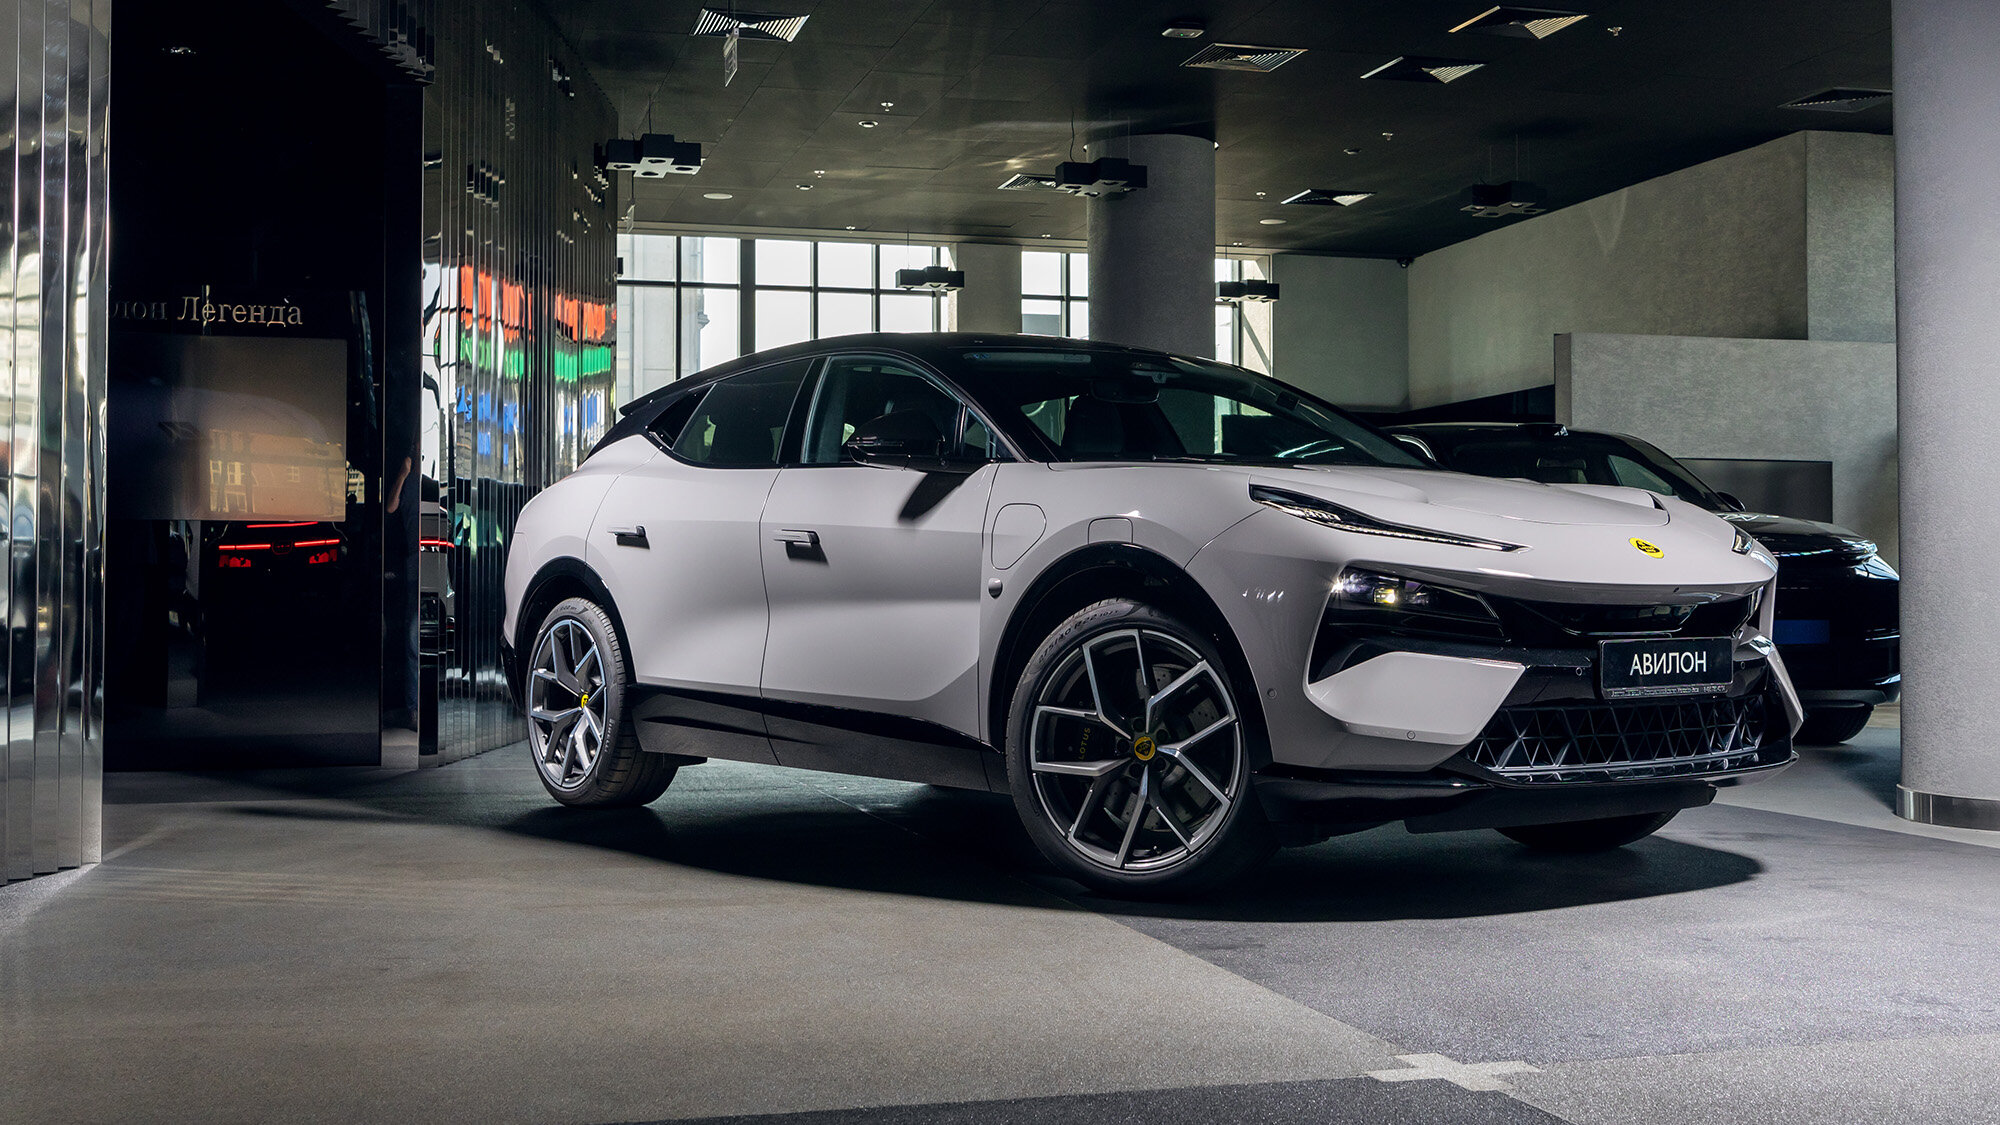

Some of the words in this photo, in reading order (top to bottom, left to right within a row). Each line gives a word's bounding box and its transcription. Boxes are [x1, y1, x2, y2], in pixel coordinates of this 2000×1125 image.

[177, 296, 303, 328] Легенда
[1630, 651, 1707, 676] АВИЛОН
[1079, 727, 1091, 760] LOTUS
